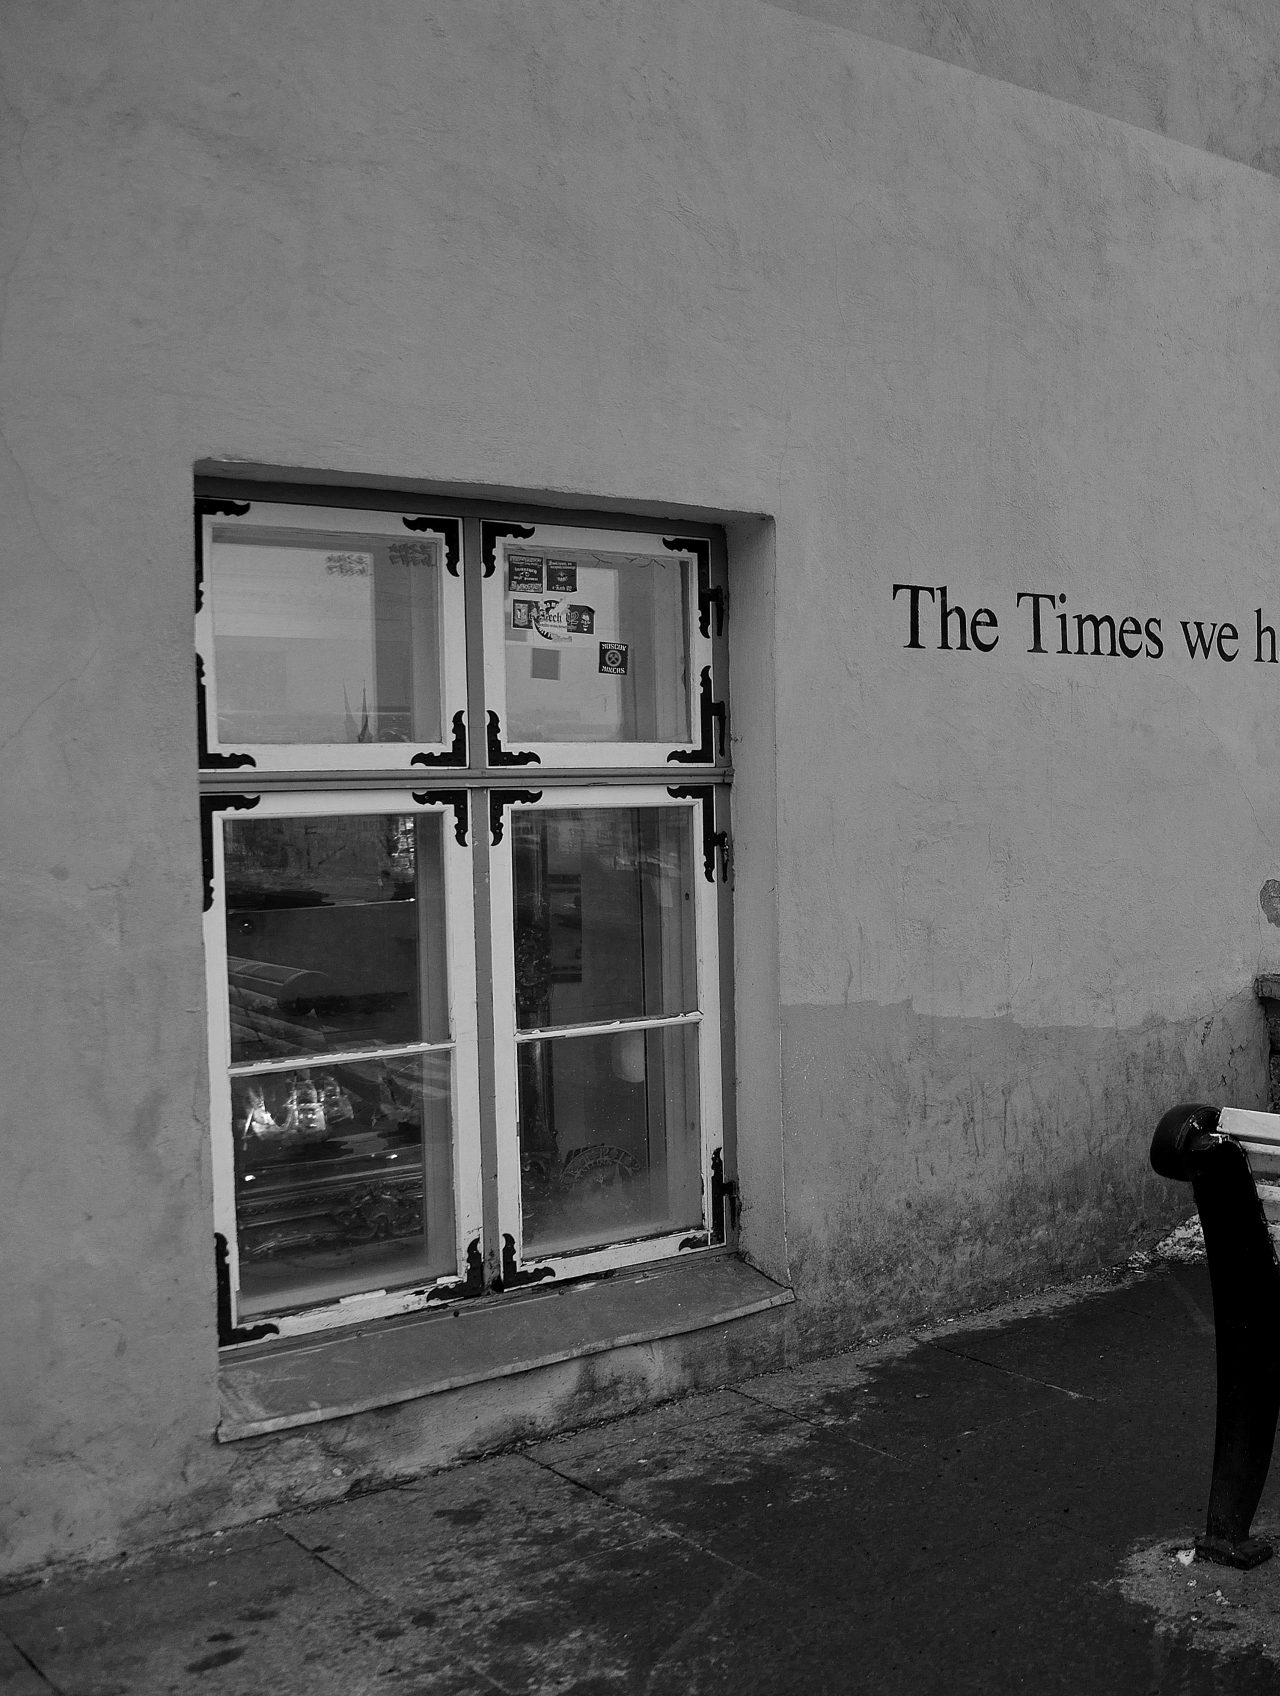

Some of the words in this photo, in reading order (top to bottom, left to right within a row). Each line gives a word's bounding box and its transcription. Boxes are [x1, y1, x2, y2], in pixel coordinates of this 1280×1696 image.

[892, 583, 1000, 653] The
[1016, 592, 1164, 659] Times
[1179, 620, 1240, 663] we
